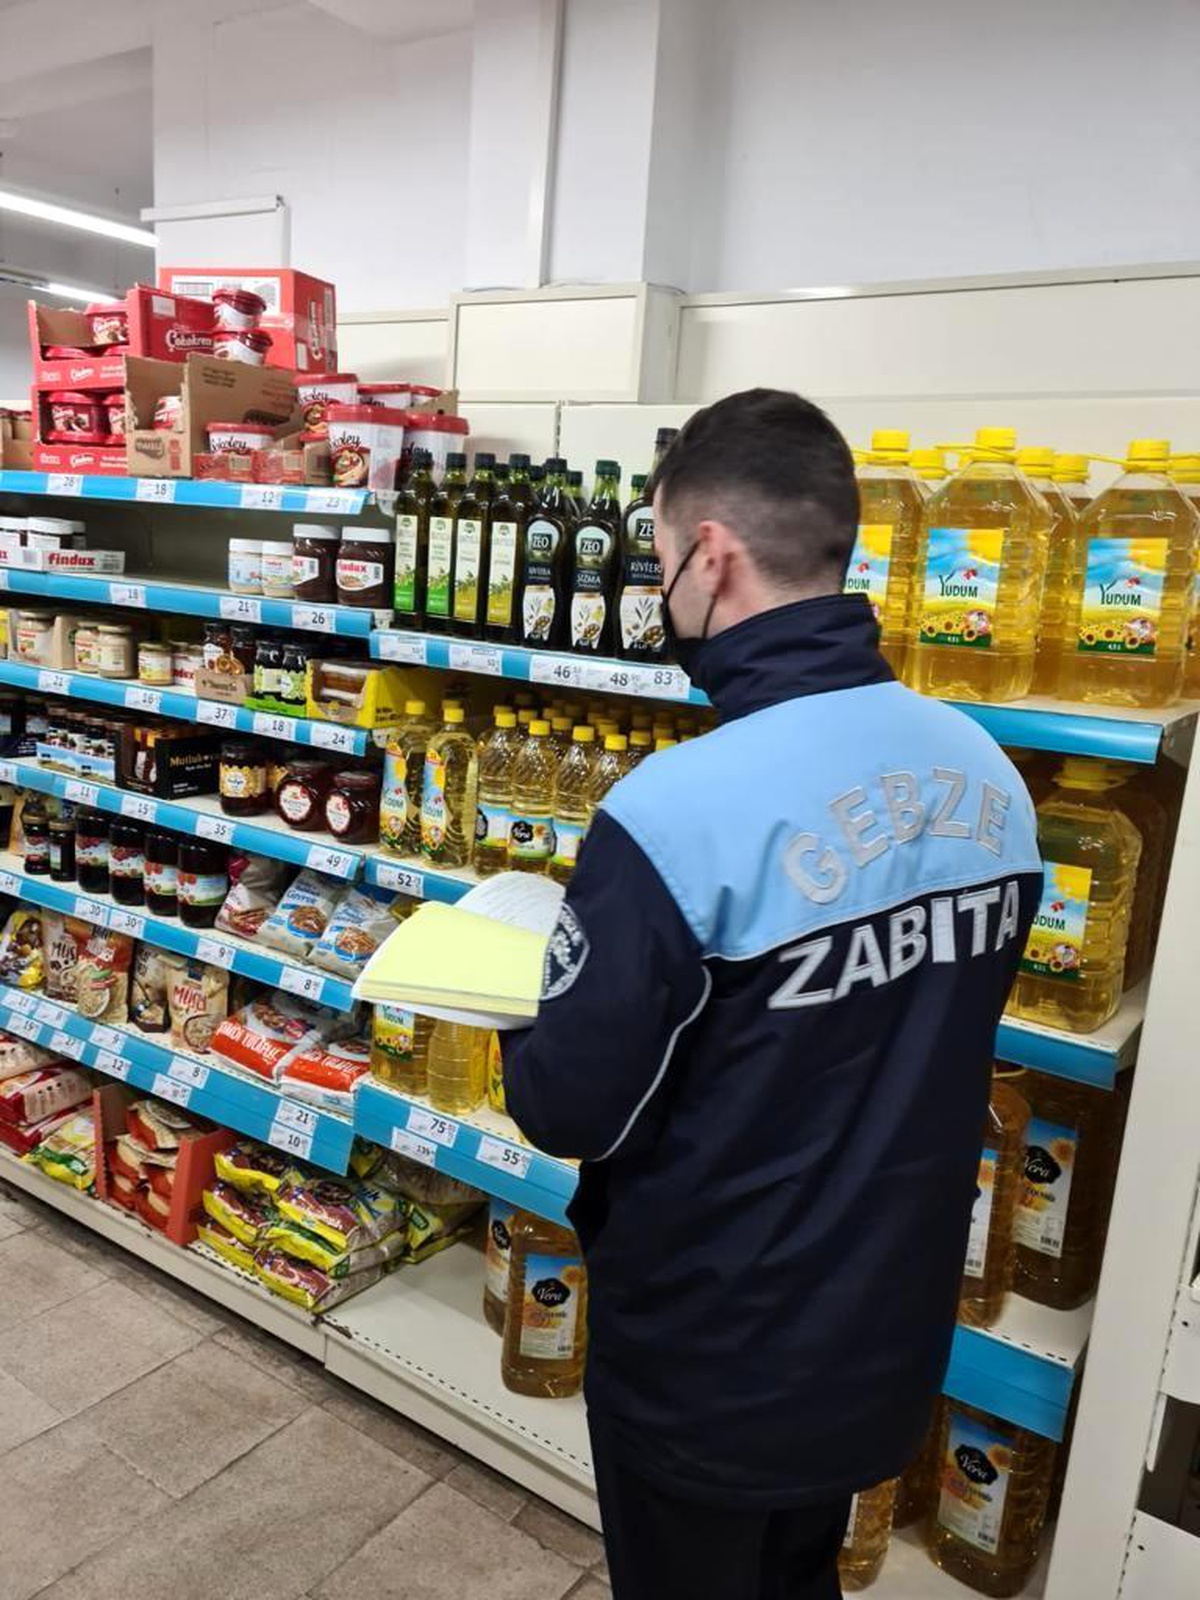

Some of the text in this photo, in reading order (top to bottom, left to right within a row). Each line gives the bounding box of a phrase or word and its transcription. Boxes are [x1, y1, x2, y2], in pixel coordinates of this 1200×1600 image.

[639, 522, 655, 537] ZE
[532, 536, 548, 549] ZEO
[581, 541, 601, 553] ZEO
[48, 553, 95, 567] findux
[847, 578, 871, 590] DUM
[238, 600, 250, 613] 21
[312, 612, 325, 625] 26
[553, 665, 571, 679] 46
[653, 671, 673, 686] 83
[609, 673, 629, 687] 48
[215, 707, 228, 719] 37
[272, 720, 284, 733] 18
[332, 733, 346, 746] 24
[214, 824, 227, 836] 35
[783, 766, 1011, 904] GEBZE
[326, 854, 341, 867] 49
[397, 873, 412, 887] 52
[89, 904, 102, 917] 30
[126, 916, 138, 928] 30
[768, 881, 1020, 1010] ZABITA
[219, 947, 226, 958] 9
[303, 979, 311, 990] 8
[112, 1058, 125, 1072] 12
[191, 1066, 200, 1078] 8
[295, 1110, 308, 1124] 21
[431, 1118, 447, 1134] 75
[287, 1134, 300, 1148] 10
[502, 1148, 520, 1165] 55
[536, 1286, 563, 1301] Vera
